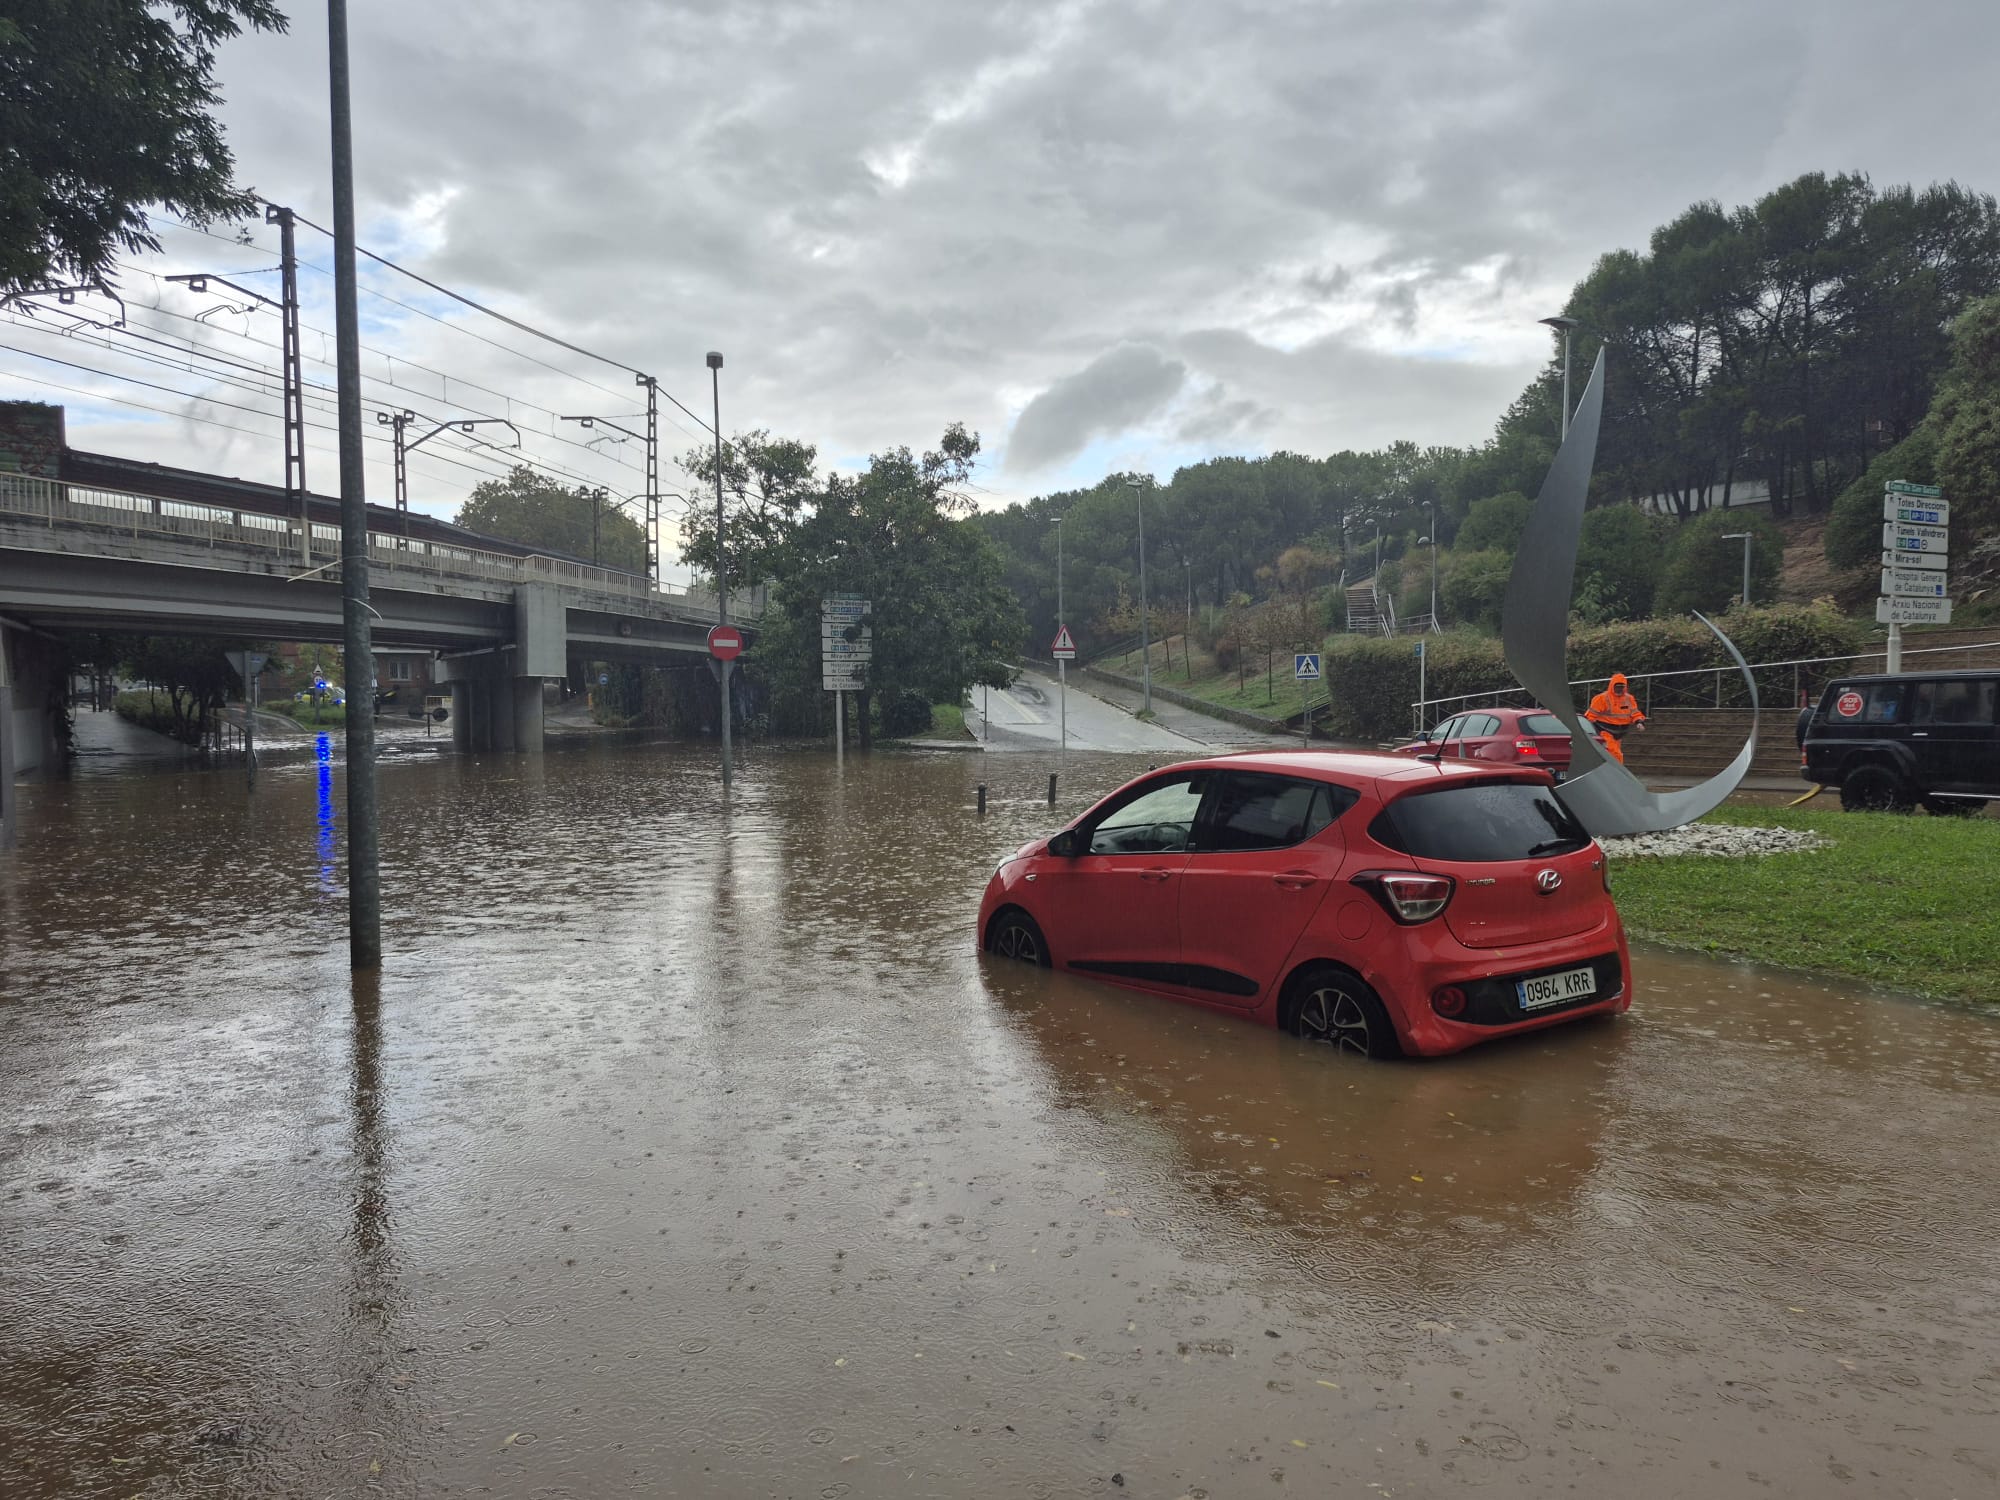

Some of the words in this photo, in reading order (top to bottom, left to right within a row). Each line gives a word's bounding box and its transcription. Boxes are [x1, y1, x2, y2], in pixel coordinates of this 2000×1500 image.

[1898, 497, 1915, 508] Totes
[1916, 500, 1947, 511] Direccions
[1895, 554, 1921, 564] Mira-sol
[1895, 571, 1918, 582] Hospital
[1921, 572, 1943, 582] General
[1895, 584, 1902, 592] de
[1904, 582, 1934, 595] Catalunya
[1892, 600, 1911, 609] Arxiu
[1912, 600, 1941, 610] Nacional
[1891, 611, 1900, 620] de
[1903, 610, 1937, 622] Catalunya
[1526, 978, 1560, 1002] 0964
[1564, 972, 1590, 995] KRR
